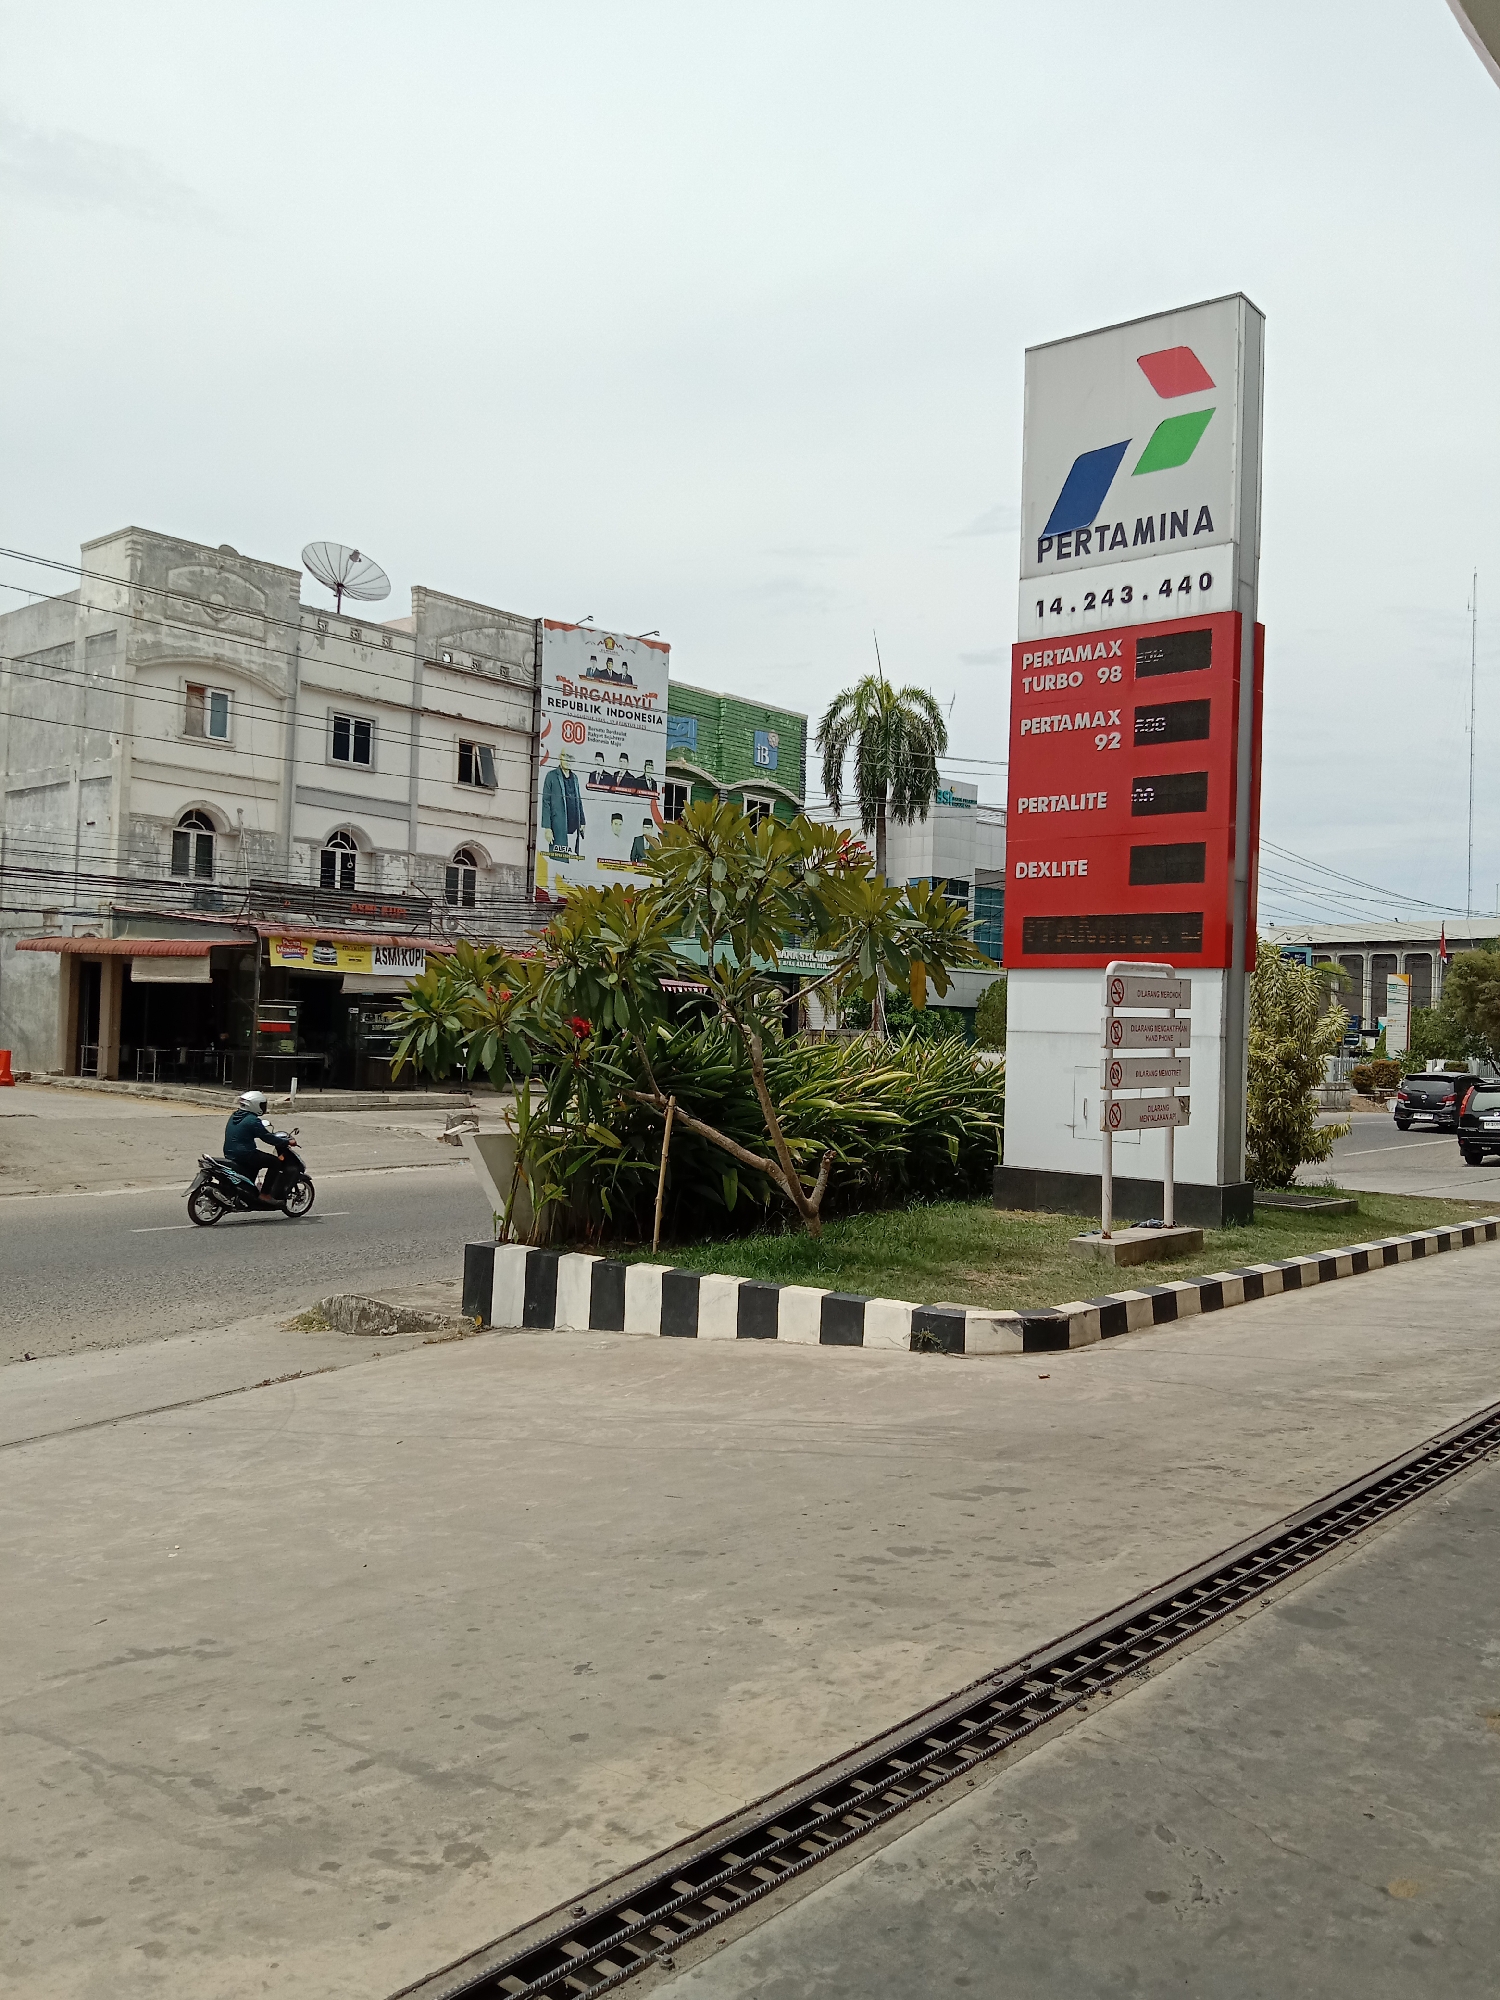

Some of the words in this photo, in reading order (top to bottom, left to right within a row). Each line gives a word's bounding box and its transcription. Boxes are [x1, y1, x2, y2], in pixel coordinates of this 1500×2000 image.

[1037, 505, 1214, 563] PERTAMINA
[1036, 572, 1213, 618] 14.243.440
[1022, 639, 1123, 670] PERTAMAX
[1022, 671, 1084, 694] TURBO
[1097, 666, 1122, 684] 98
[562, 683, 652, 710] DIRGAHAYU
[547, 697, 601, 714] REPUBLIK
[606, 707, 663, 725] INDONESIA
[1020, 709, 1122, 736] PERTAMAX
[562, 720, 586, 745] 80
[1095, 732, 1122, 751] 92
[1018, 791, 1108, 814] PERTALITE
[1015, 859, 1089, 879] DEXLITE
[375, 946, 400, 966] ASMI
[401, 948, 424, 967] KUPI
[1137, 989, 1160, 998] DILARANG
[1147, 1104, 1169, 1112] DILARANG
